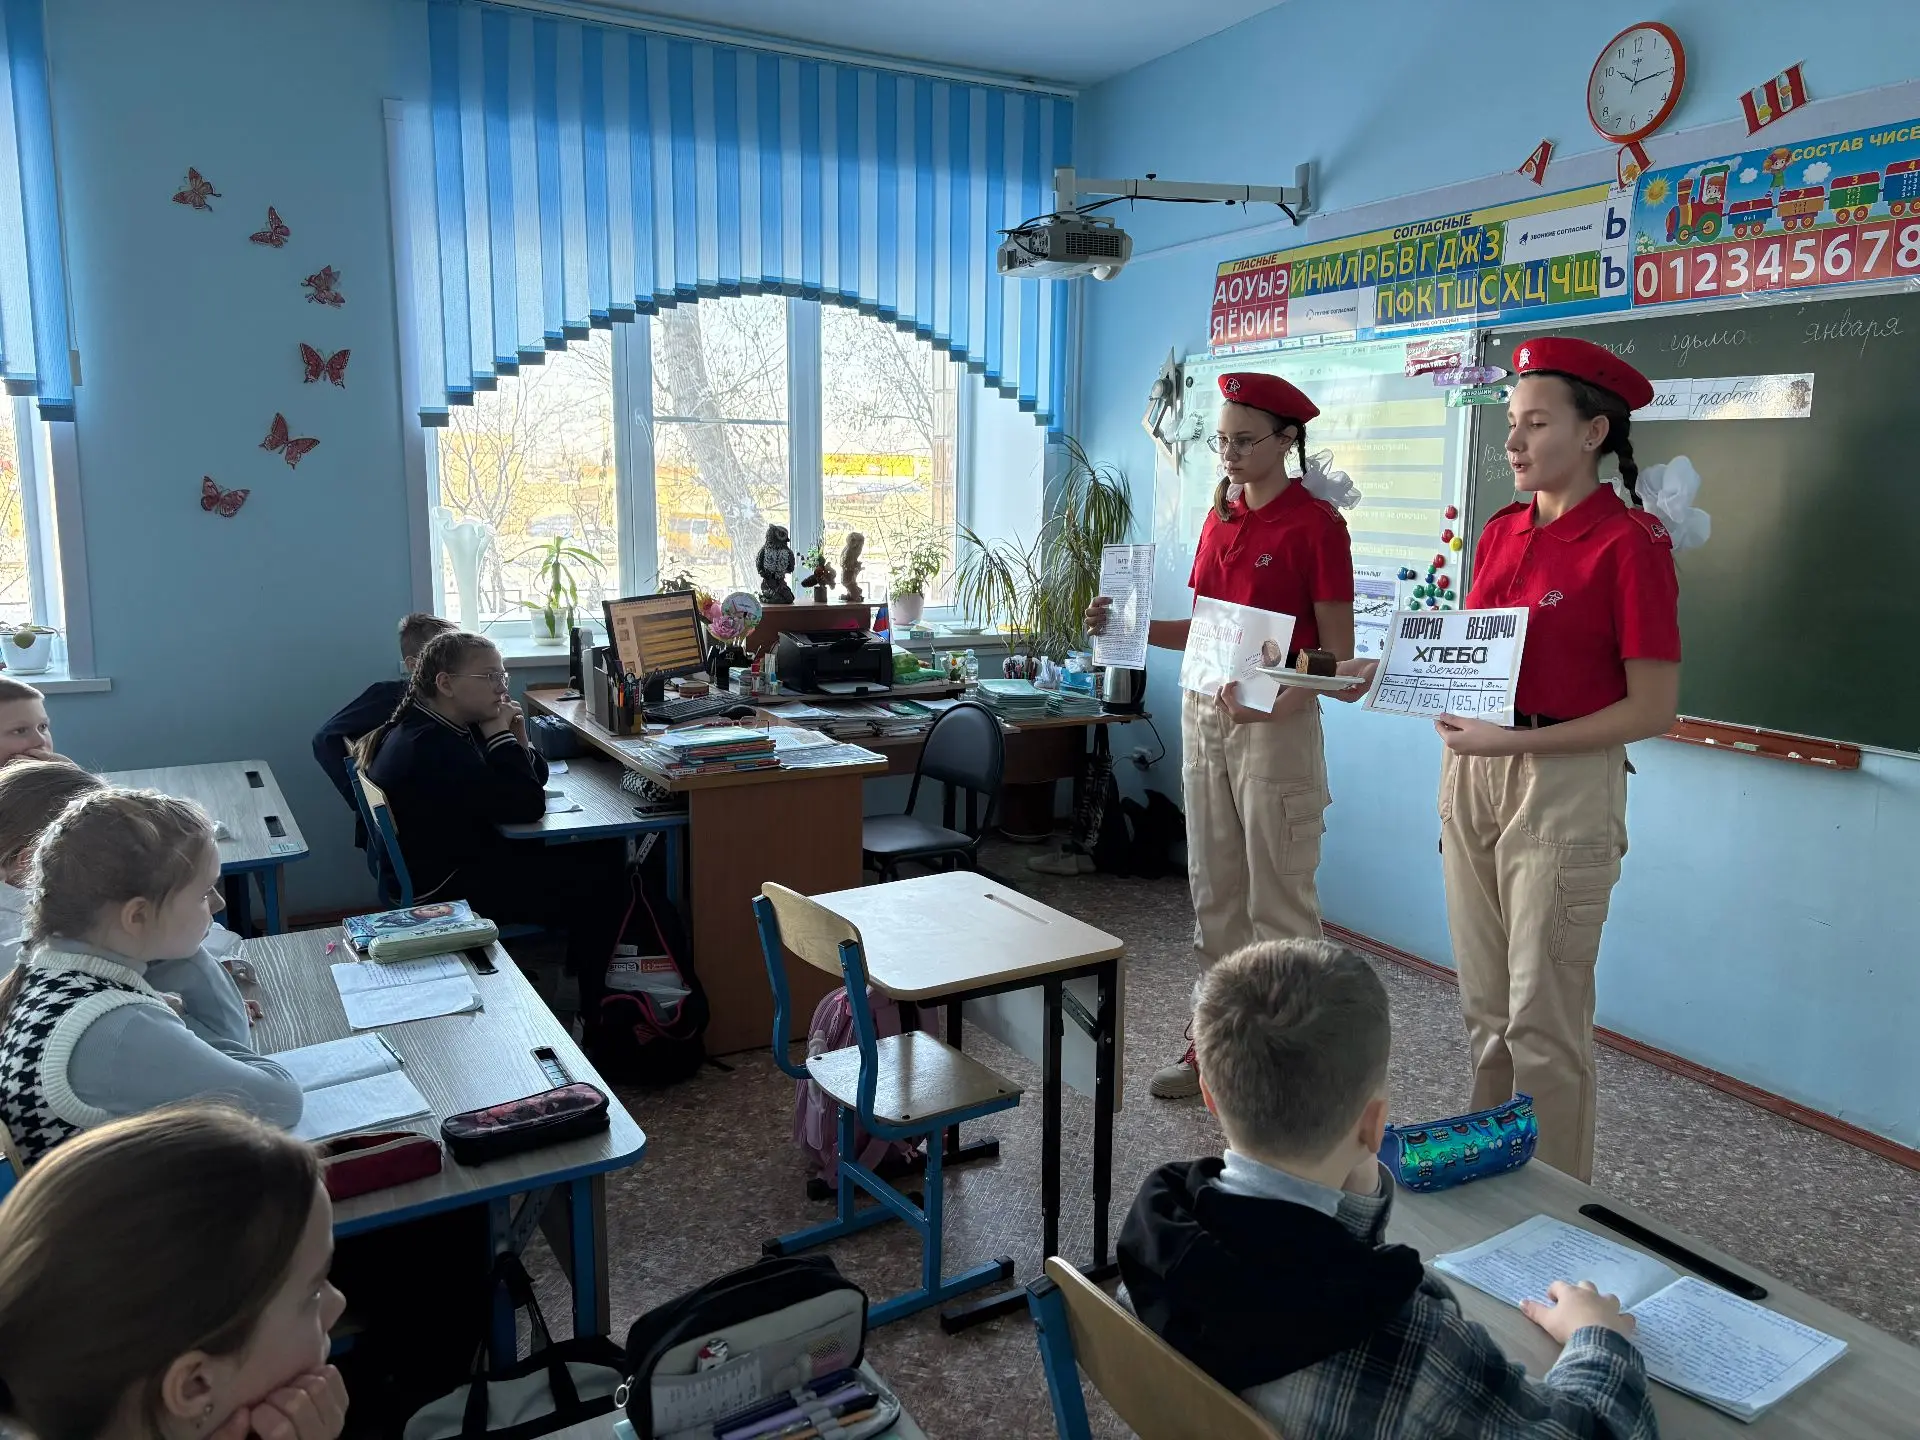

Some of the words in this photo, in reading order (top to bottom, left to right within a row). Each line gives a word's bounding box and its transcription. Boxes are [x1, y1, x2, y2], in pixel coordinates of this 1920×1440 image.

[1617, 48, 1625, 59] 11
[1634, 36, 1643, 54] 12
[1664, 48, 1670, 60] 2
[1605, 66, 1614, 78] 10
[1599, 84, 1605, 101] 9
[1660, 91, 1667, 102] 4
[1615, 117, 1622, 129] 7
[1629, 114, 1636, 131] 6
[1647, 109, 1654, 122] 5
[1791, 138, 1864, 162] СОСТАВ
[1515, 138, 1554, 187] А
[1851, 176, 1859, 185] 3
[1393, 213, 1473, 240] СОГЛАСНЫЕ
[1530, 230, 1556, 241] ЗВОНКИЕ
[1556, 223, 1593, 237] СОГЛАСНЫЕ
[1232, 254, 1278, 272] ГЛАСНЫЕ
[1802, 308, 1904, 359] января
[1400, 617, 1443, 640] НОРМА
[1465, 614, 1518, 641] ВЫДАЧИ
